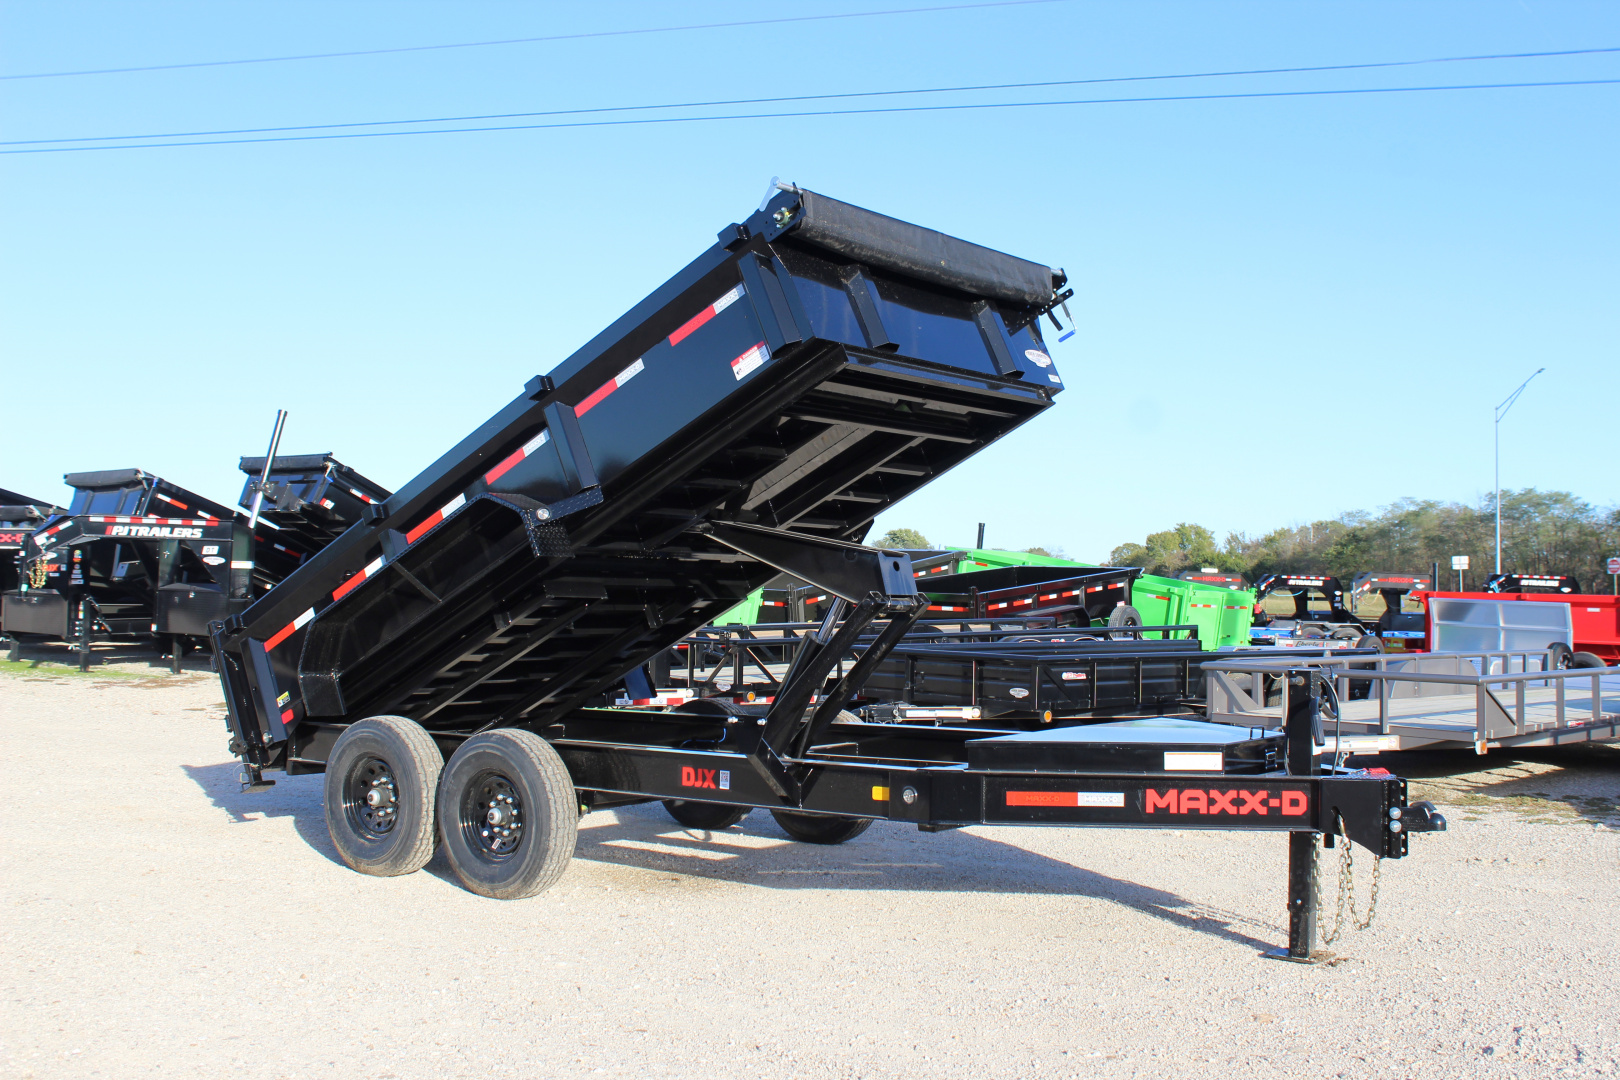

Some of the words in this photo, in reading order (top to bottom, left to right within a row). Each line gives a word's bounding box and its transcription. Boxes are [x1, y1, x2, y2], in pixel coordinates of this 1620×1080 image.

[111, 525, 129, 536] PJ
[129, 526, 203, 538] TRAILERS
[682, 766, 717, 789] DJX
[1085, 796, 1119, 804] MAXX-D
[1146, 789, 1307, 815] MAXX-D
